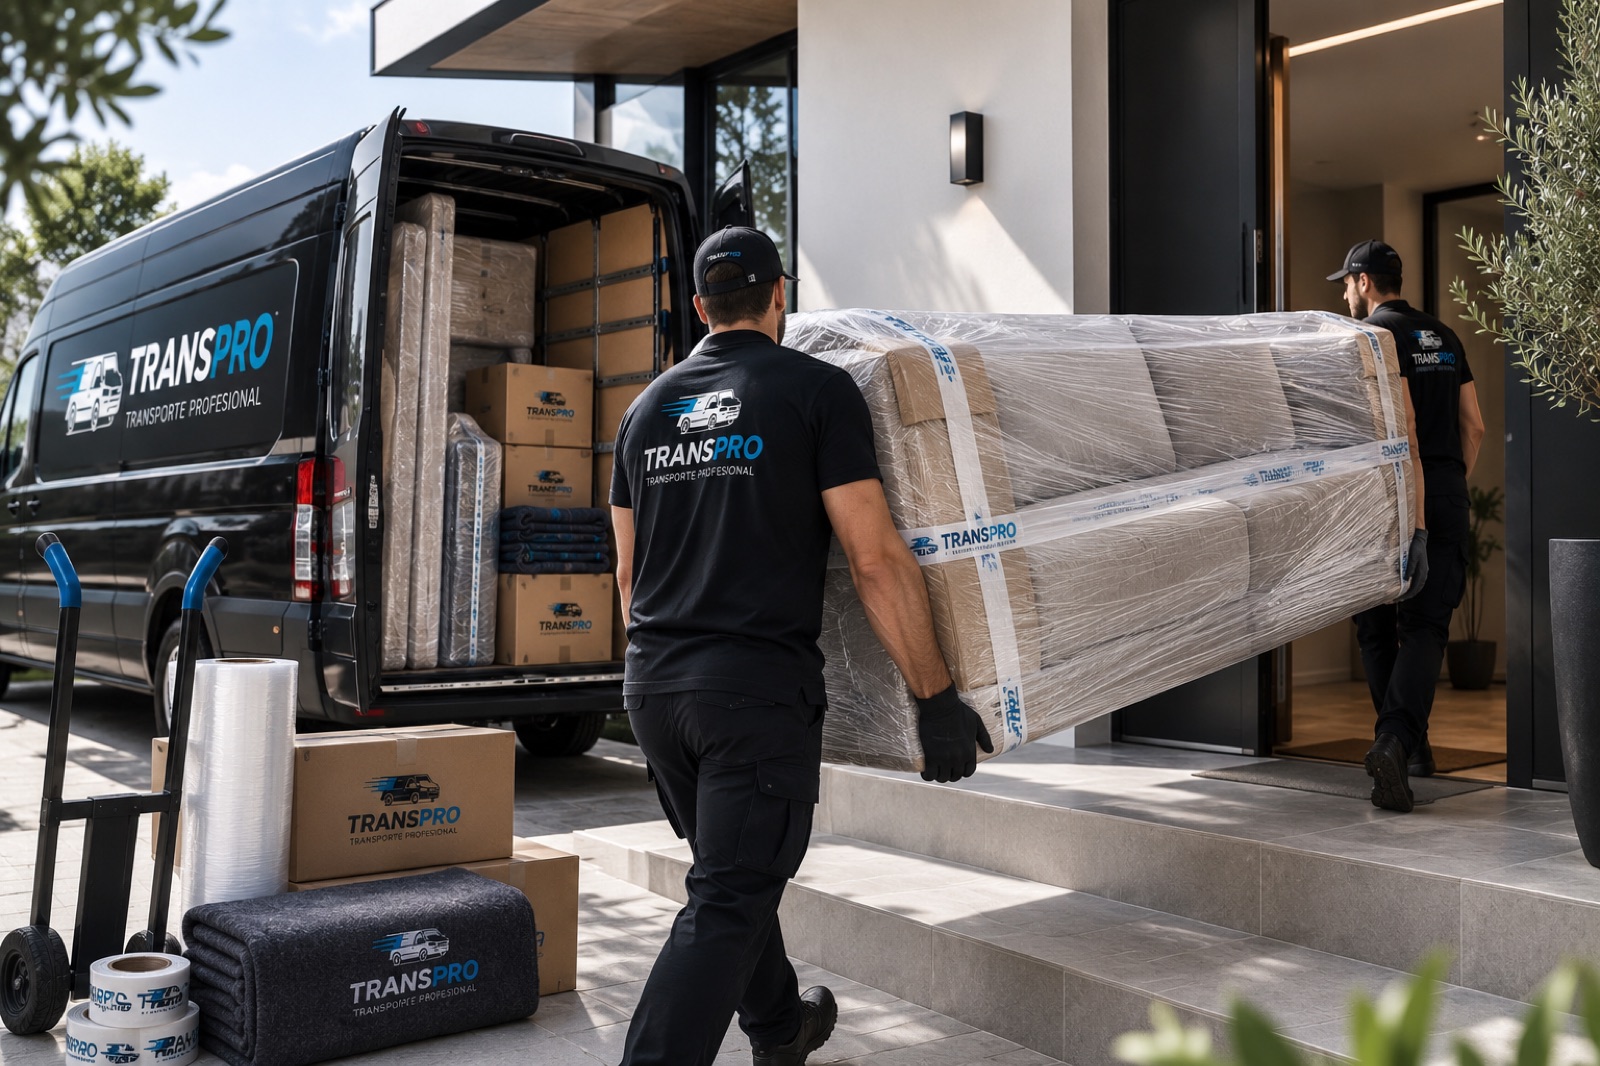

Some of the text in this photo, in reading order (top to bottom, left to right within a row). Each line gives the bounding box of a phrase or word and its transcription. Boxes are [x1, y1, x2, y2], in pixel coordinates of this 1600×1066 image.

[129, 312, 274, 396] TRANSPRO
[125, 386, 262, 429] TRANSPORTE PROFESIONAL
[526, 406, 575, 418] TRANSPRO
[643, 434, 764, 472] TRANSPRO
[646, 465, 755, 487] TRANSPORTE PROFESIONAL
[941, 521, 1017, 550] TRANSPRO
[538, 619, 593, 631] TRANSPRO
[347, 805, 461, 834] TRANSPRO
[350, 827, 458, 846] TRANSPORTE PROFESIONAL
[349, 959, 479, 1005] TRANSPRO
